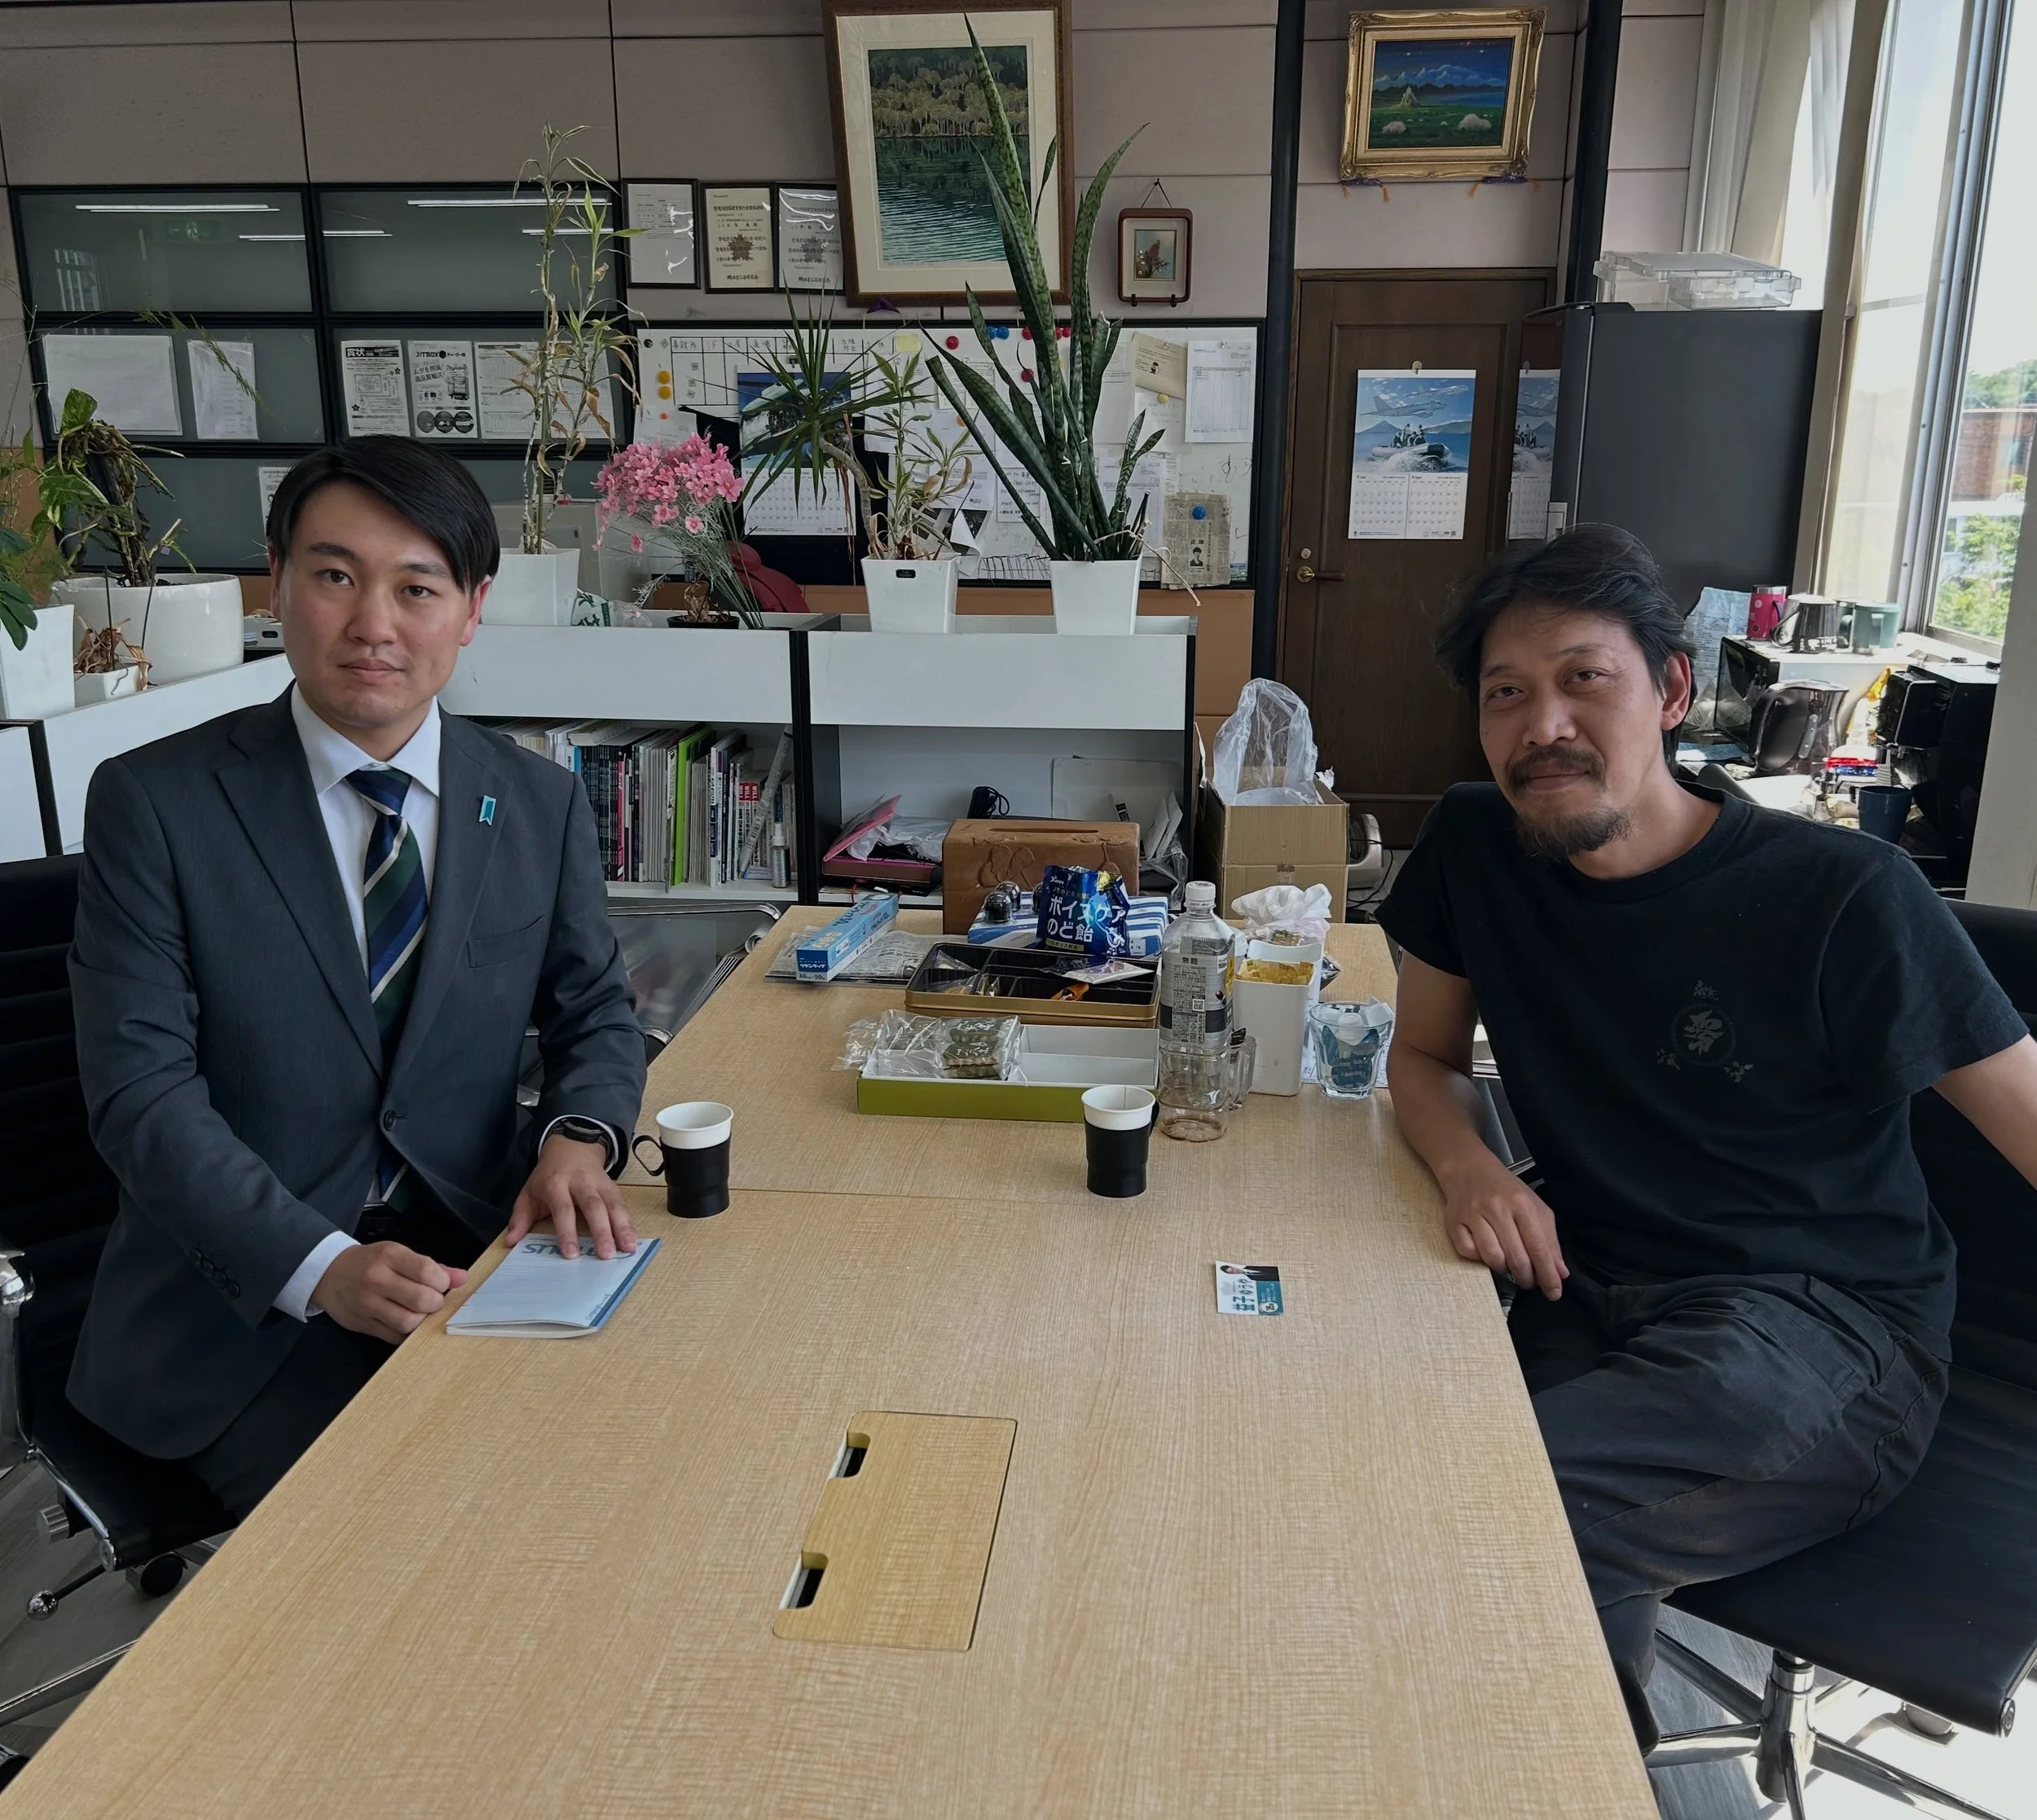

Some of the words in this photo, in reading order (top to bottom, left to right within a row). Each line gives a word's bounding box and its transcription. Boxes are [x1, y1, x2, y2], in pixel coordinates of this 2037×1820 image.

[1049, 895, 1126, 924] ボイスケア
[1047, 917, 1093, 943] のど飴
